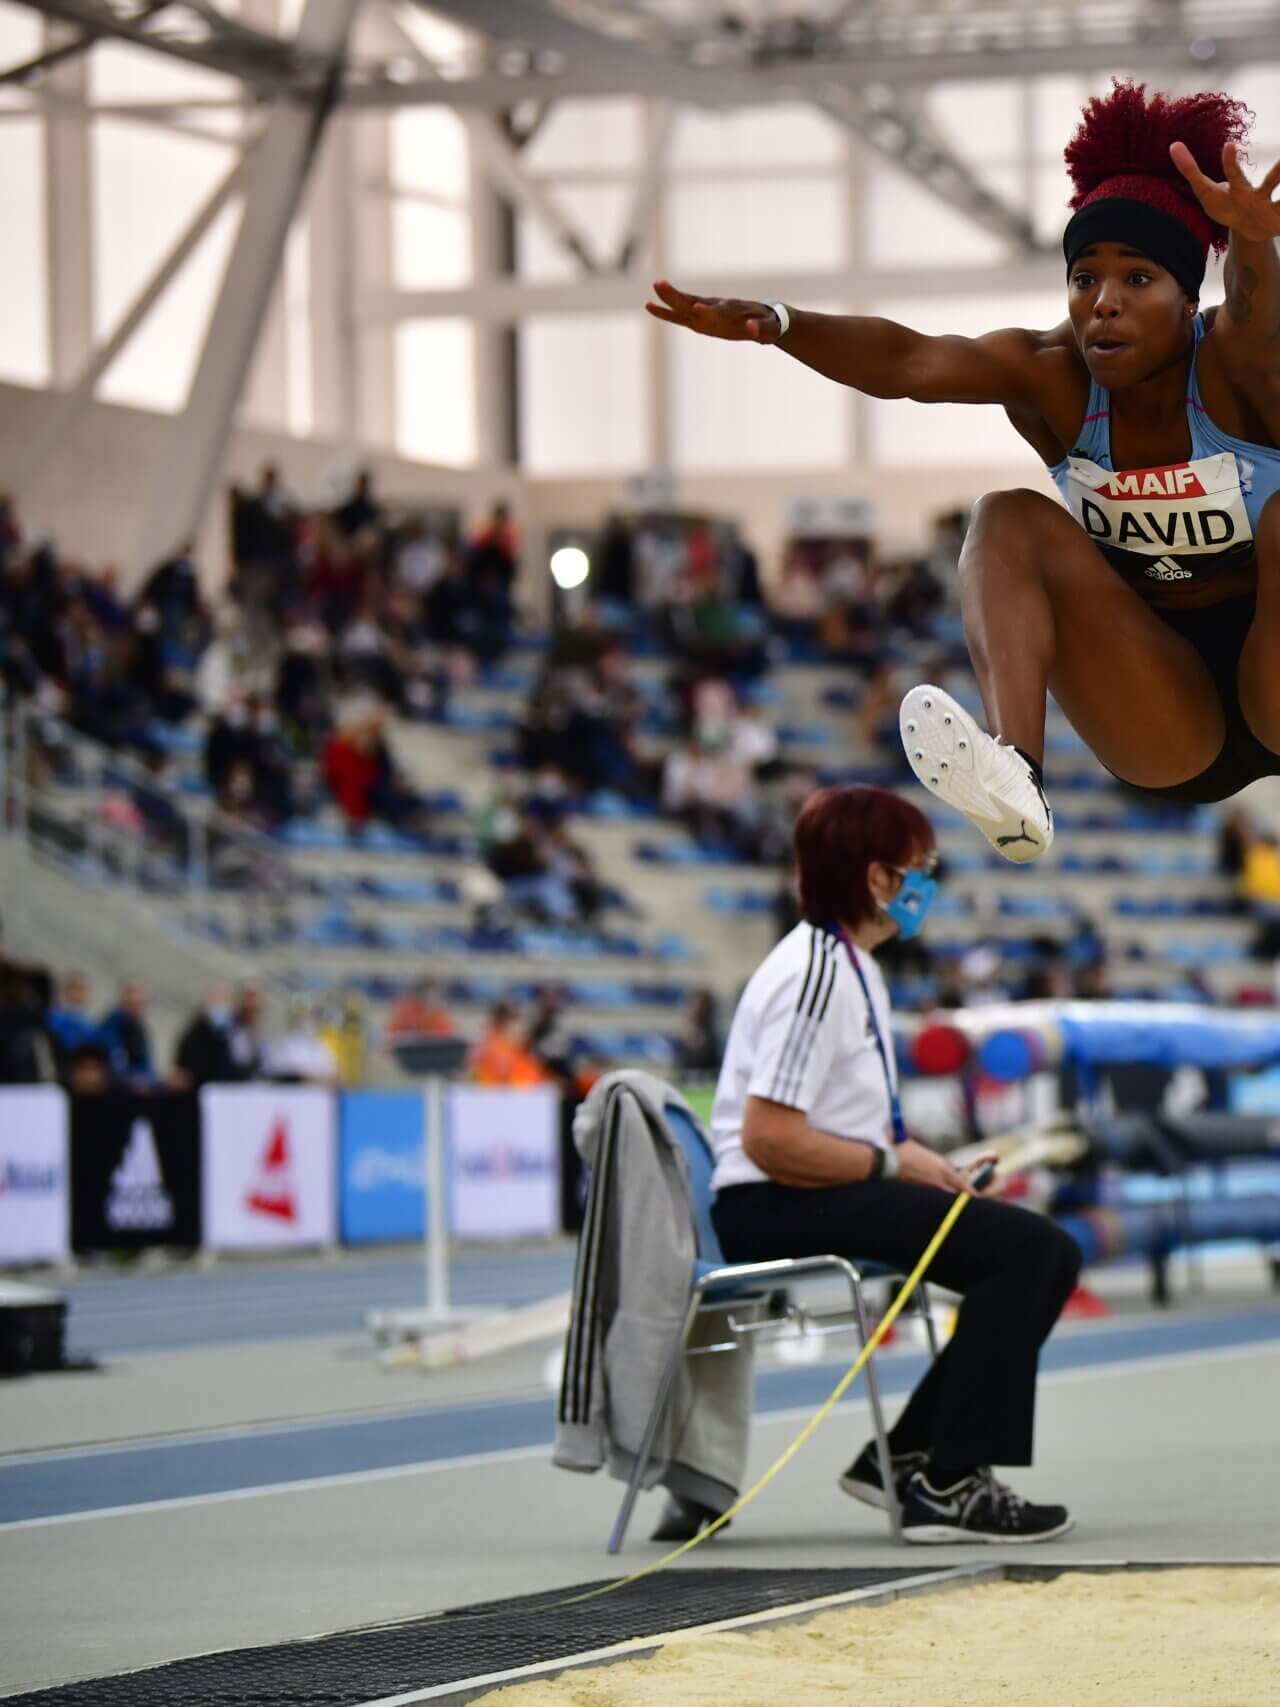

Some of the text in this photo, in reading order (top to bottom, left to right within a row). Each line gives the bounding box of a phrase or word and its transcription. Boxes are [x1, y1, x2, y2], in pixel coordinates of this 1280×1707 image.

[1108, 468, 1196, 496] MAIF
[1081, 497, 1235, 546] DAVID
[1144, 567, 1193, 581] adidas
